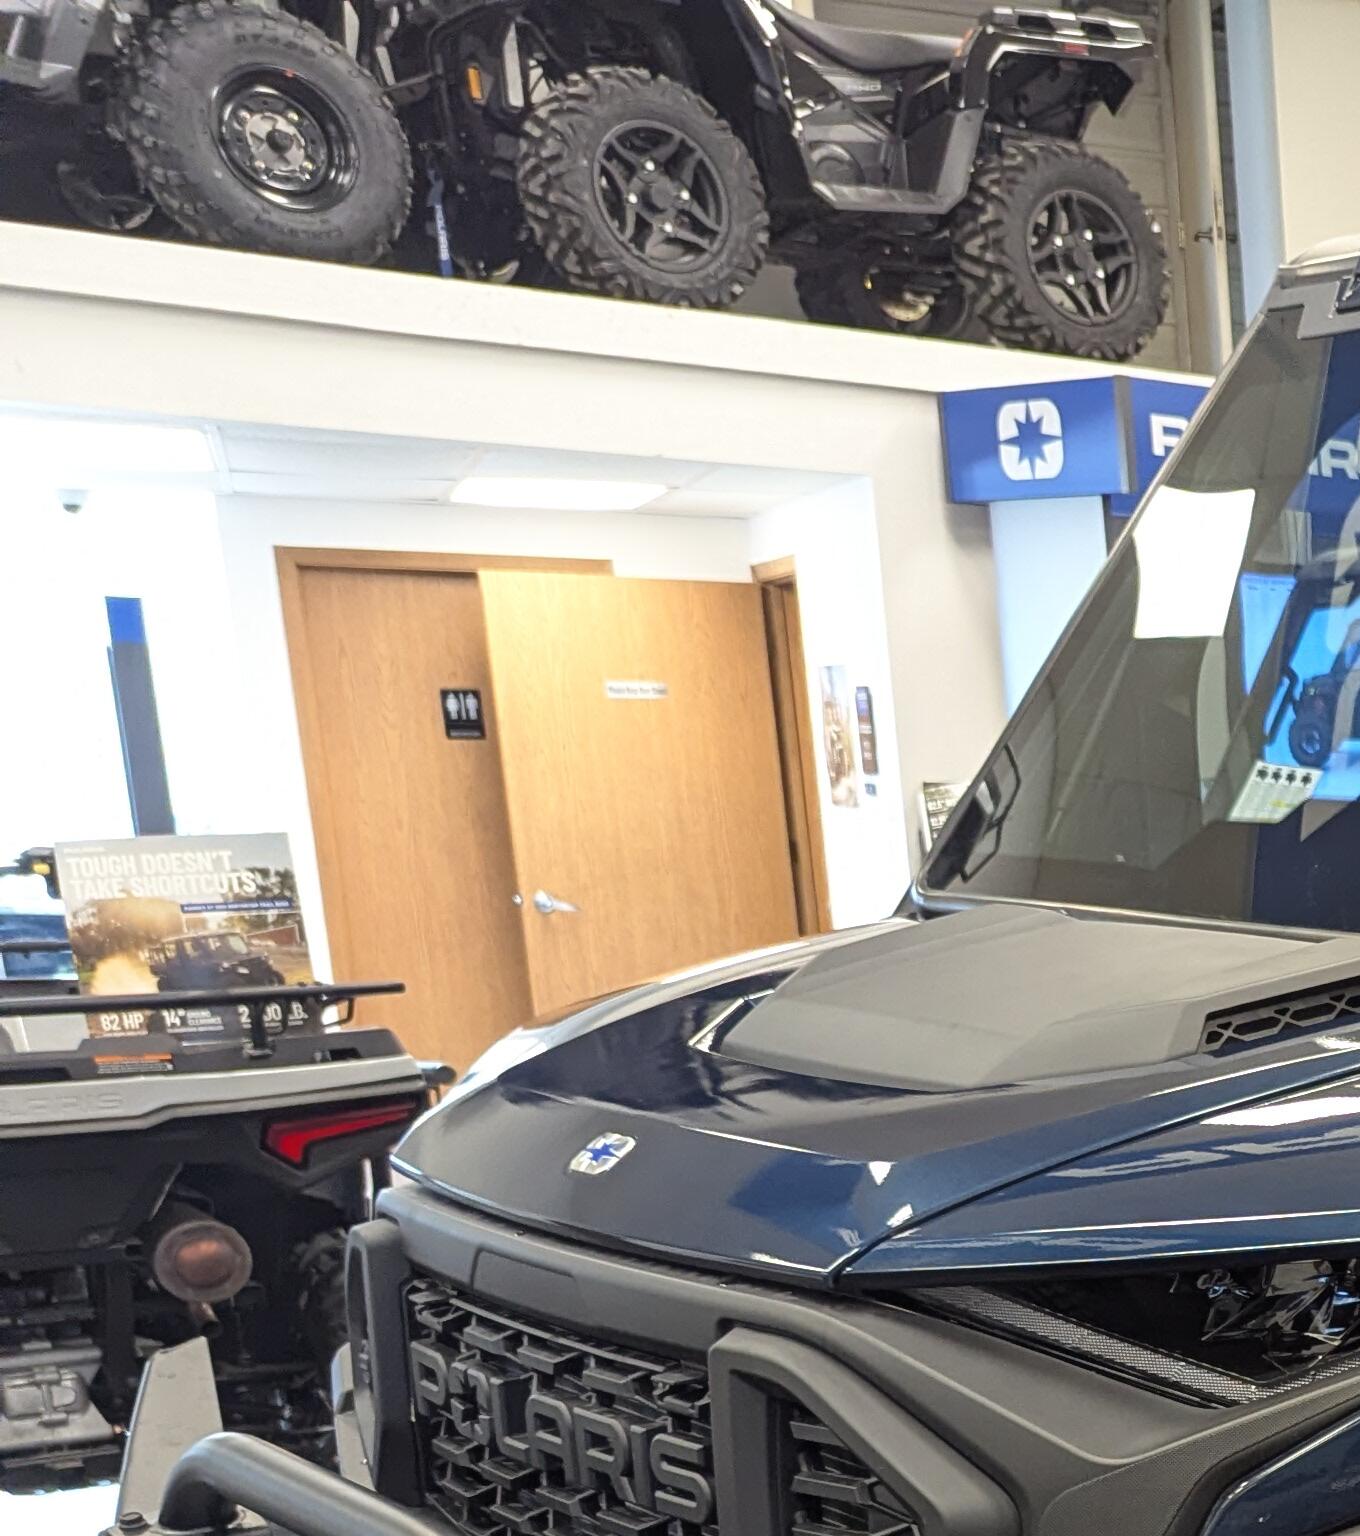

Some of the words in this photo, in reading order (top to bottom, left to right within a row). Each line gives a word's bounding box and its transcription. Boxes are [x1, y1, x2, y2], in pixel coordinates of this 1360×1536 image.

[66, 853, 137, 878] TOUGH
[141, 850, 233, 875] DOESN'T
[69, 877, 128, 900] TAKE
[131, 872, 258, 899] SHORTCUTS
[101, 1013, 121, 1031] 82
[122, 1010, 144, 1030] HP
[410, 1340, 712, 1524] POLARIS
